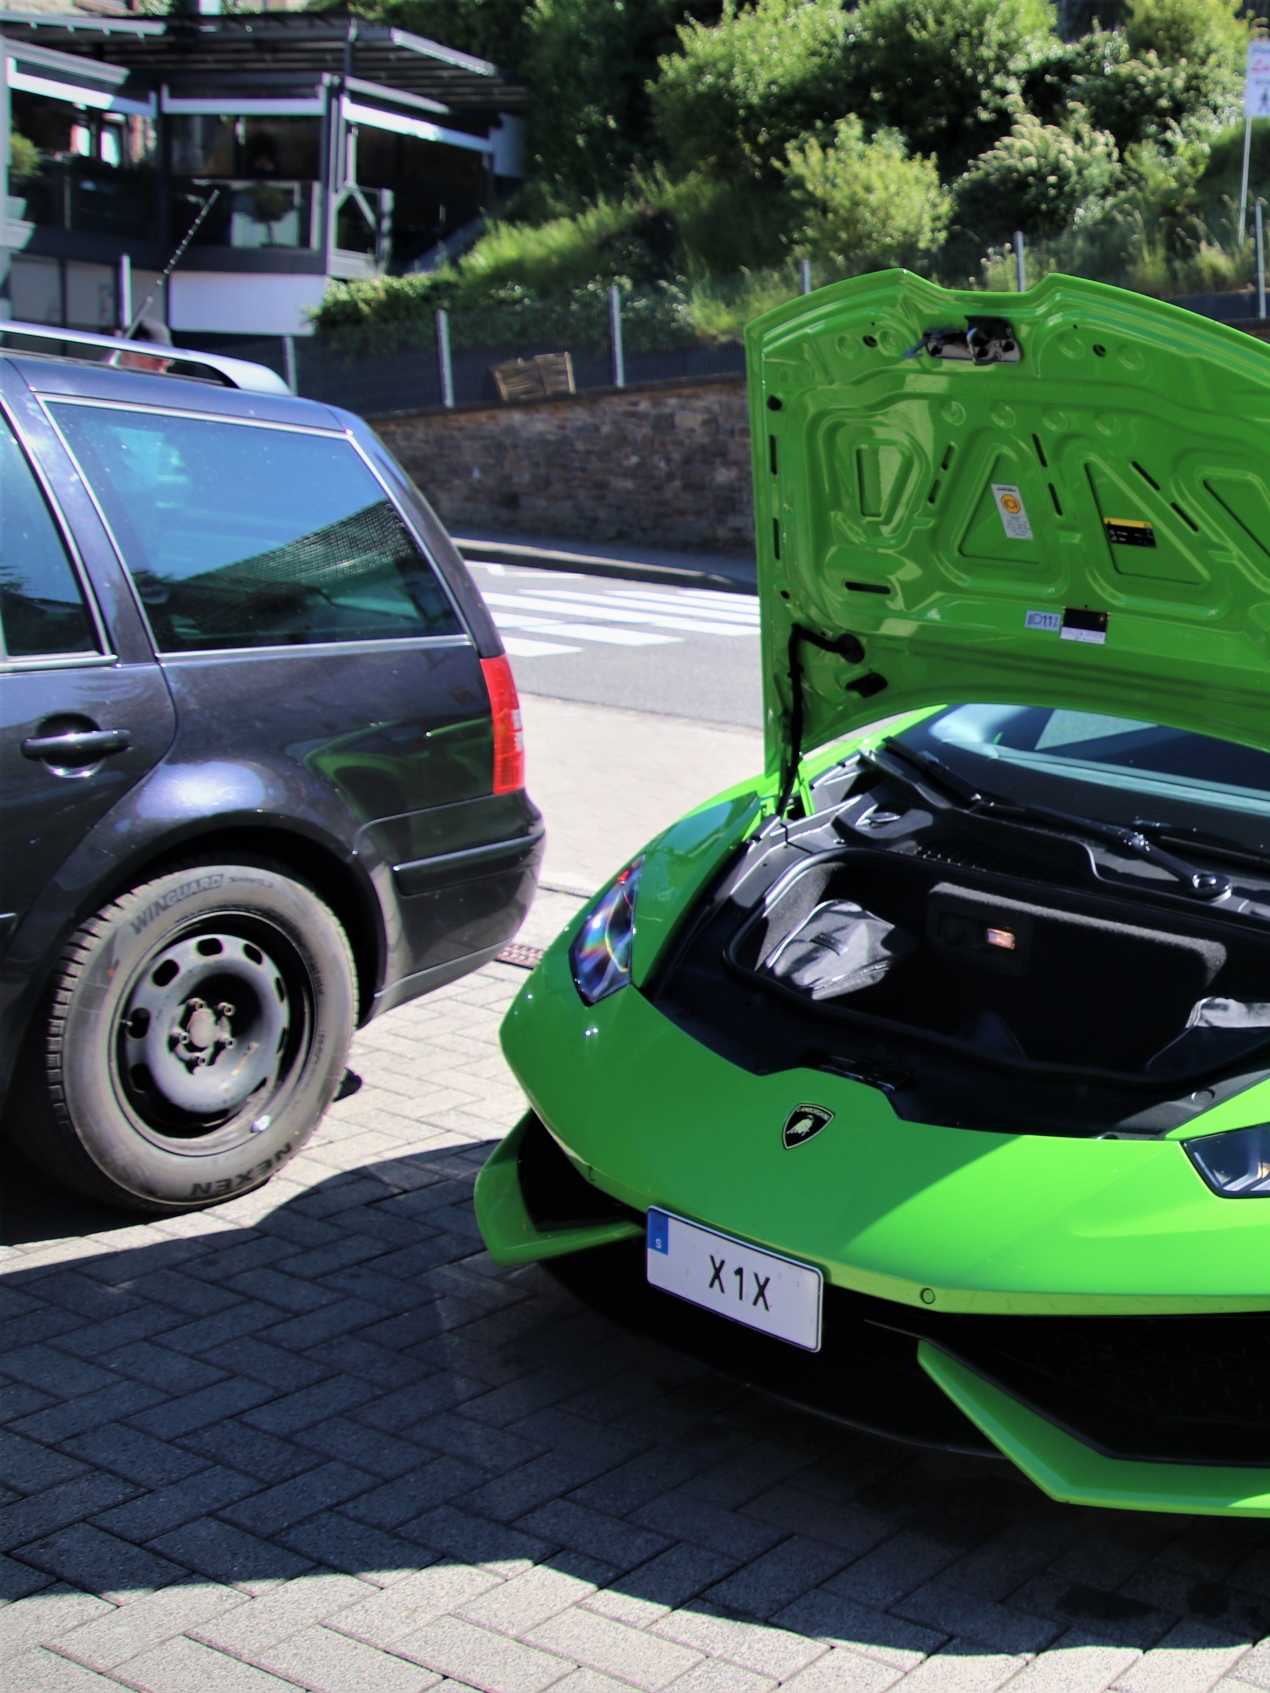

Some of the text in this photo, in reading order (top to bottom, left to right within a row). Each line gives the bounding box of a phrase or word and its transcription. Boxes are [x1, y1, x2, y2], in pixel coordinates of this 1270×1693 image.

[129, 873, 225, 935] WINGUARD
[189, 1142, 292, 1197] NEXEN
[654, 1238, 662, 1249] S
[708, 1254, 771, 1312] X1X
